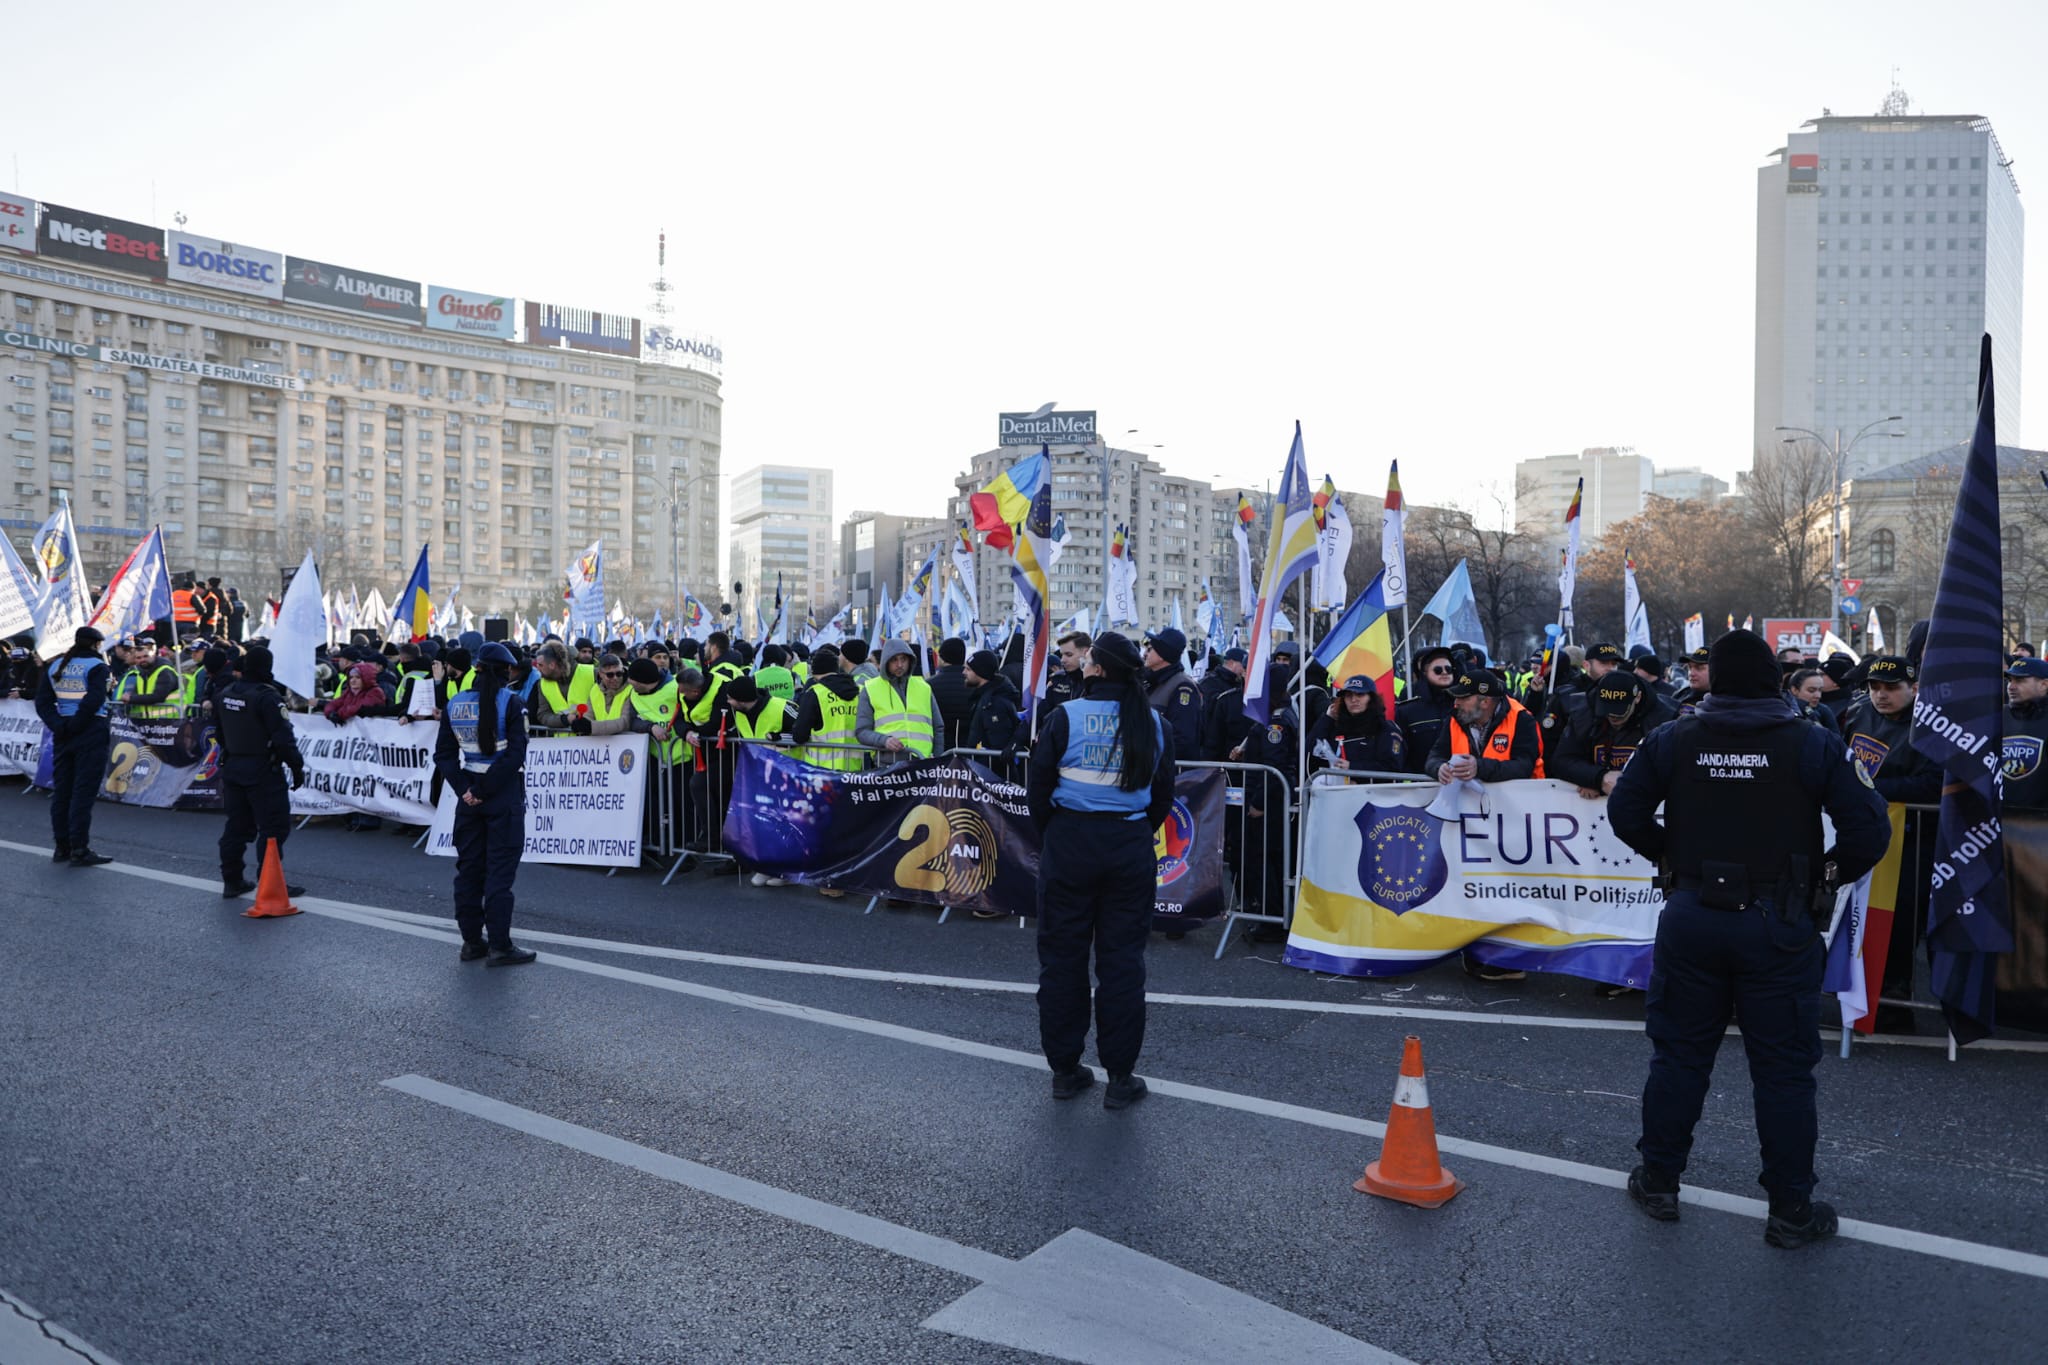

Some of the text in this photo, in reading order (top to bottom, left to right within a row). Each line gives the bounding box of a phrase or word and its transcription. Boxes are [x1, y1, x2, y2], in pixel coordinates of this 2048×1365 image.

[49, 219, 161, 262] NetBet
[177, 242, 275, 284] BORSEC
[334, 274, 416, 307] ALBACHER
[438, 294, 503, 322] Giusto
[4, 332, 89, 357] CLINIC
[1000, 415, 1095, 435] DentalMed
[1777, 634, 1821, 649] SALE
[1600, 688, 1627, 701] SNPP
[453, 704, 480, 720] DIAL
[1913, 692, 1989, 755] ațional
[547, 744, 611, 771] NAȚIONALĂ
[1696, 753, 1769, 767] JANDARMERIA
[2001, 746, 2035, 760] SNPP
[525, 771, 609, 788] ELOR MILITARE
[841, 771, 912, 786] Sindicatul
[1709, 767, 1754, 779] D.G.J.M.B.
[545, 789, 556, 810] ÎN
[559, 793, 626, 810] RETRAGERE
[851, 791, 864, 805] și
[867, 788, 881, 802] al
[884, 784, 968, 802] Personalului
[535, 815, 554, 832] DIN
[1368, 815, 1432, 841] SINDICATUL
[525, 837, 636, 858] FACERILOR INTERNE
[950, 842, 980, 860] ANI
[1372, 881, 1428, 902] EUROPOL
[1464, 882, 1567, 901] Sindicatul
